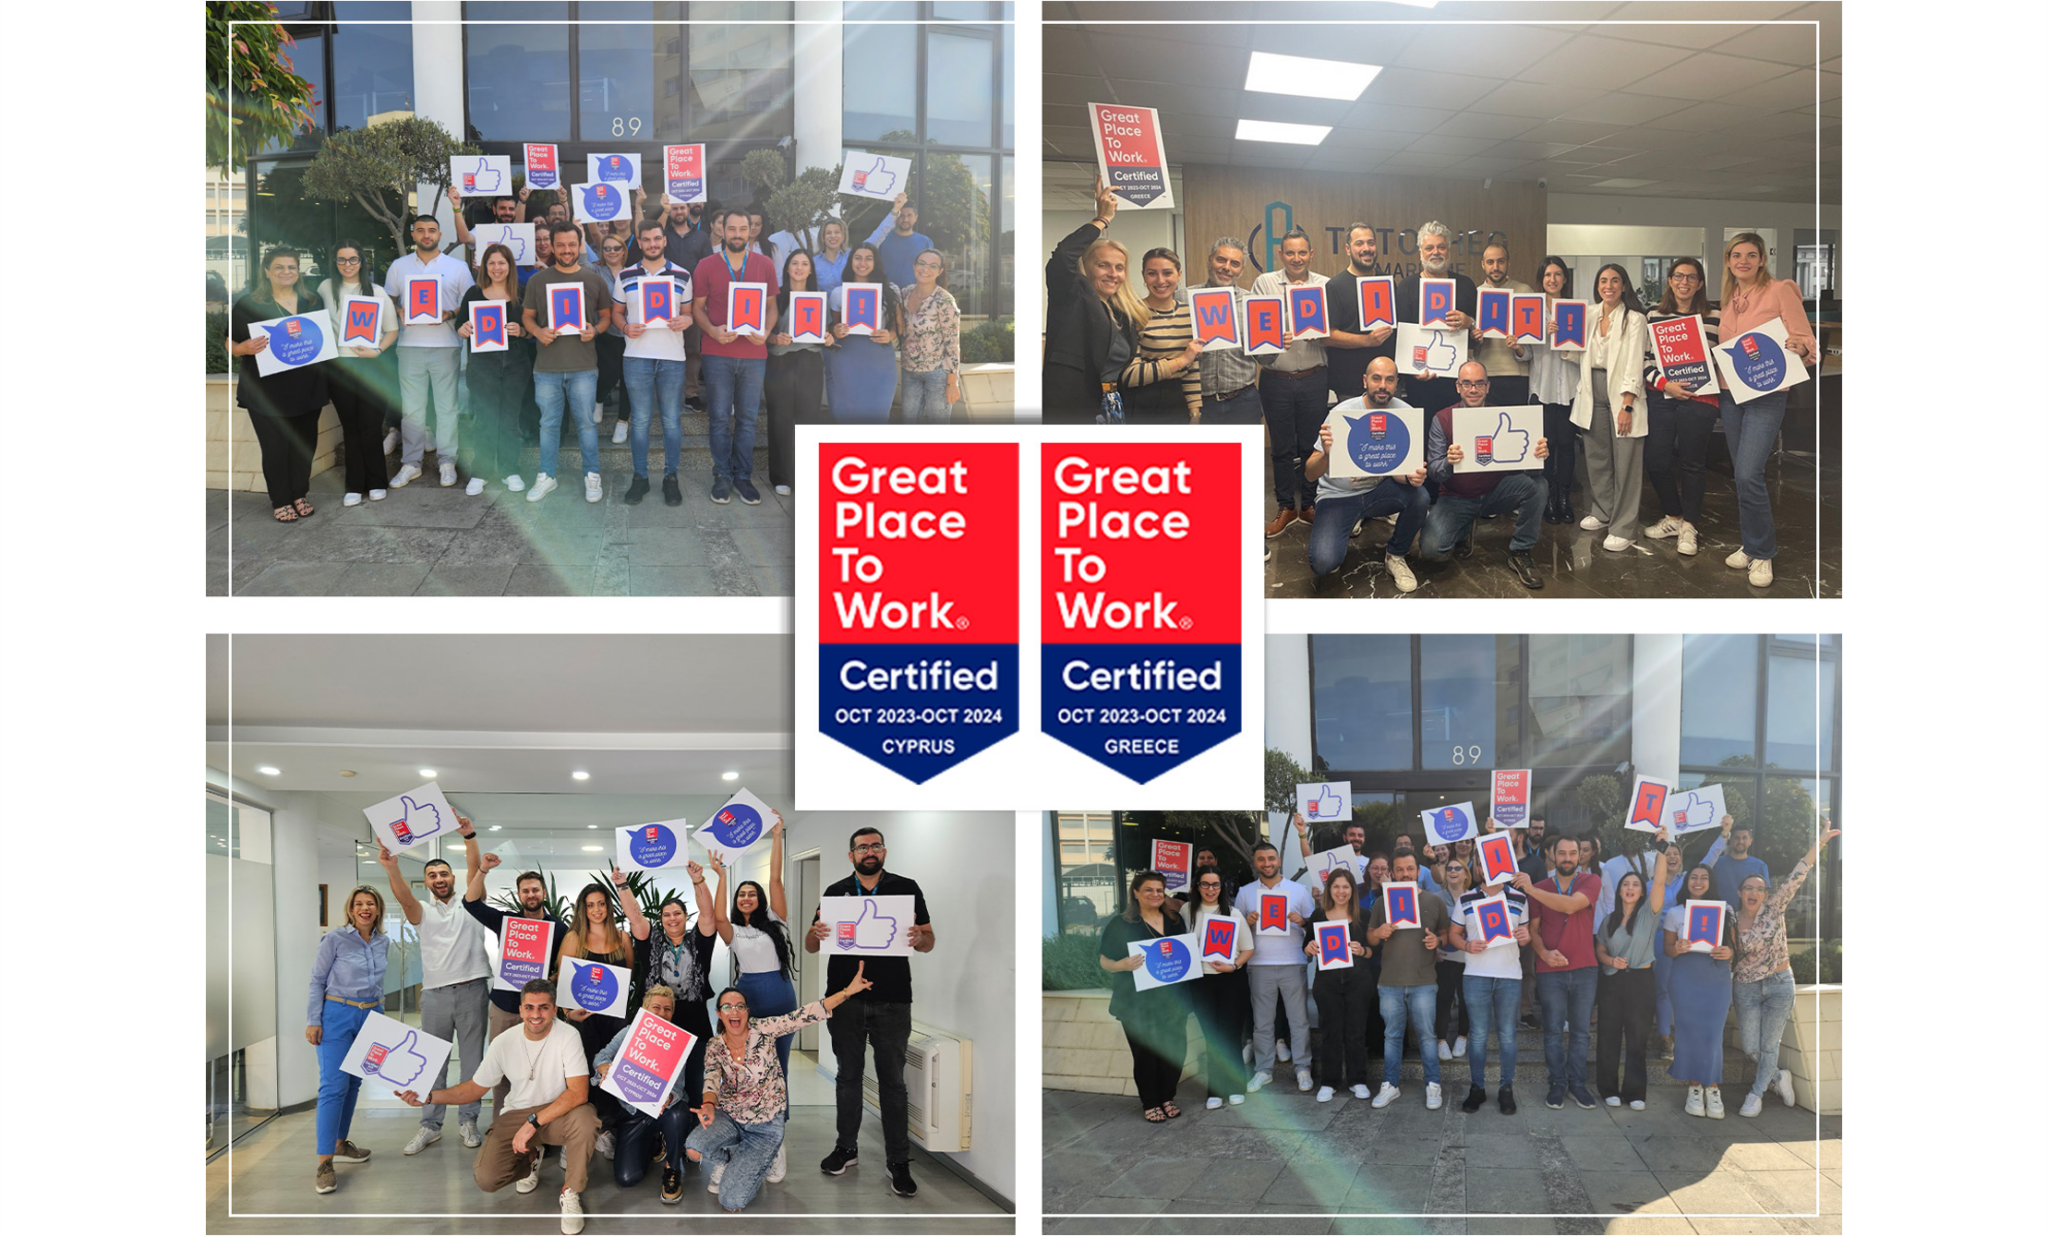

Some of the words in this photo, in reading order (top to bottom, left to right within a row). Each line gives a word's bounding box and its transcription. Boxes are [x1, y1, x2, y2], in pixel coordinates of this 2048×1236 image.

[1101, 110, 1140, 123] Great
[612, 117, 641, 137] 89
[1104, 123, 1141, 136] Place
[1105, 137, 1121, 148] To
[1115, 171, 1158, 180] Certified
[420, 290, 428, 304] E
[651, 292, 664, 307] D
[1374, 292, 1380, 308] I
[1431, 293, 1445, 309] D
[564, 299, 569, 314] I
[745, 299, 750, 314] I
[1301, 300, 1316, 317] D
[1492, 303, 1497, 318] I
[352, 311, 374, 327] W
[803, 308, 814, 322] T
[1200, 305, 1228, 325] W
[1260, 312, 1271, 331] E
[1522, 308, 1534, 323] T
[482, 316, 496, 331] D
[1656, 322, 1686, 334] Great
[1659, 333, 1688, 344] Place
[1661, 345, 1672, 353] To
[1668, 365, 1704, 376] Certified
[1364, 452, 1380, 461] great
[1381, 452, 1396, 460] place
[1453, 746, 1481, 765] 89
[1646, 794, 1657, 810] T
[1158, 843, 1181, 851] Great
[1495, 849, 1501, 863] I
[1270, 904, 1278, 917] E
[1399, 897, 1404, 910] I
[510, 921, 538, 932] Great
[1487, 912, 1500, 927] D
[509, 930, 537, 941] Place
[1210, 929, 1231, 944] W
[508, 939, 519, 948] To
[1327, 936, 1340, 950] D
[506, 963, 539, 973] Certified
[644, 1017, 677, 1040] Great
[635, 1037, 646, 1050] To
[639, 1027, 671, 1050] Place
[623, 1065, 661, 1090] Certified
